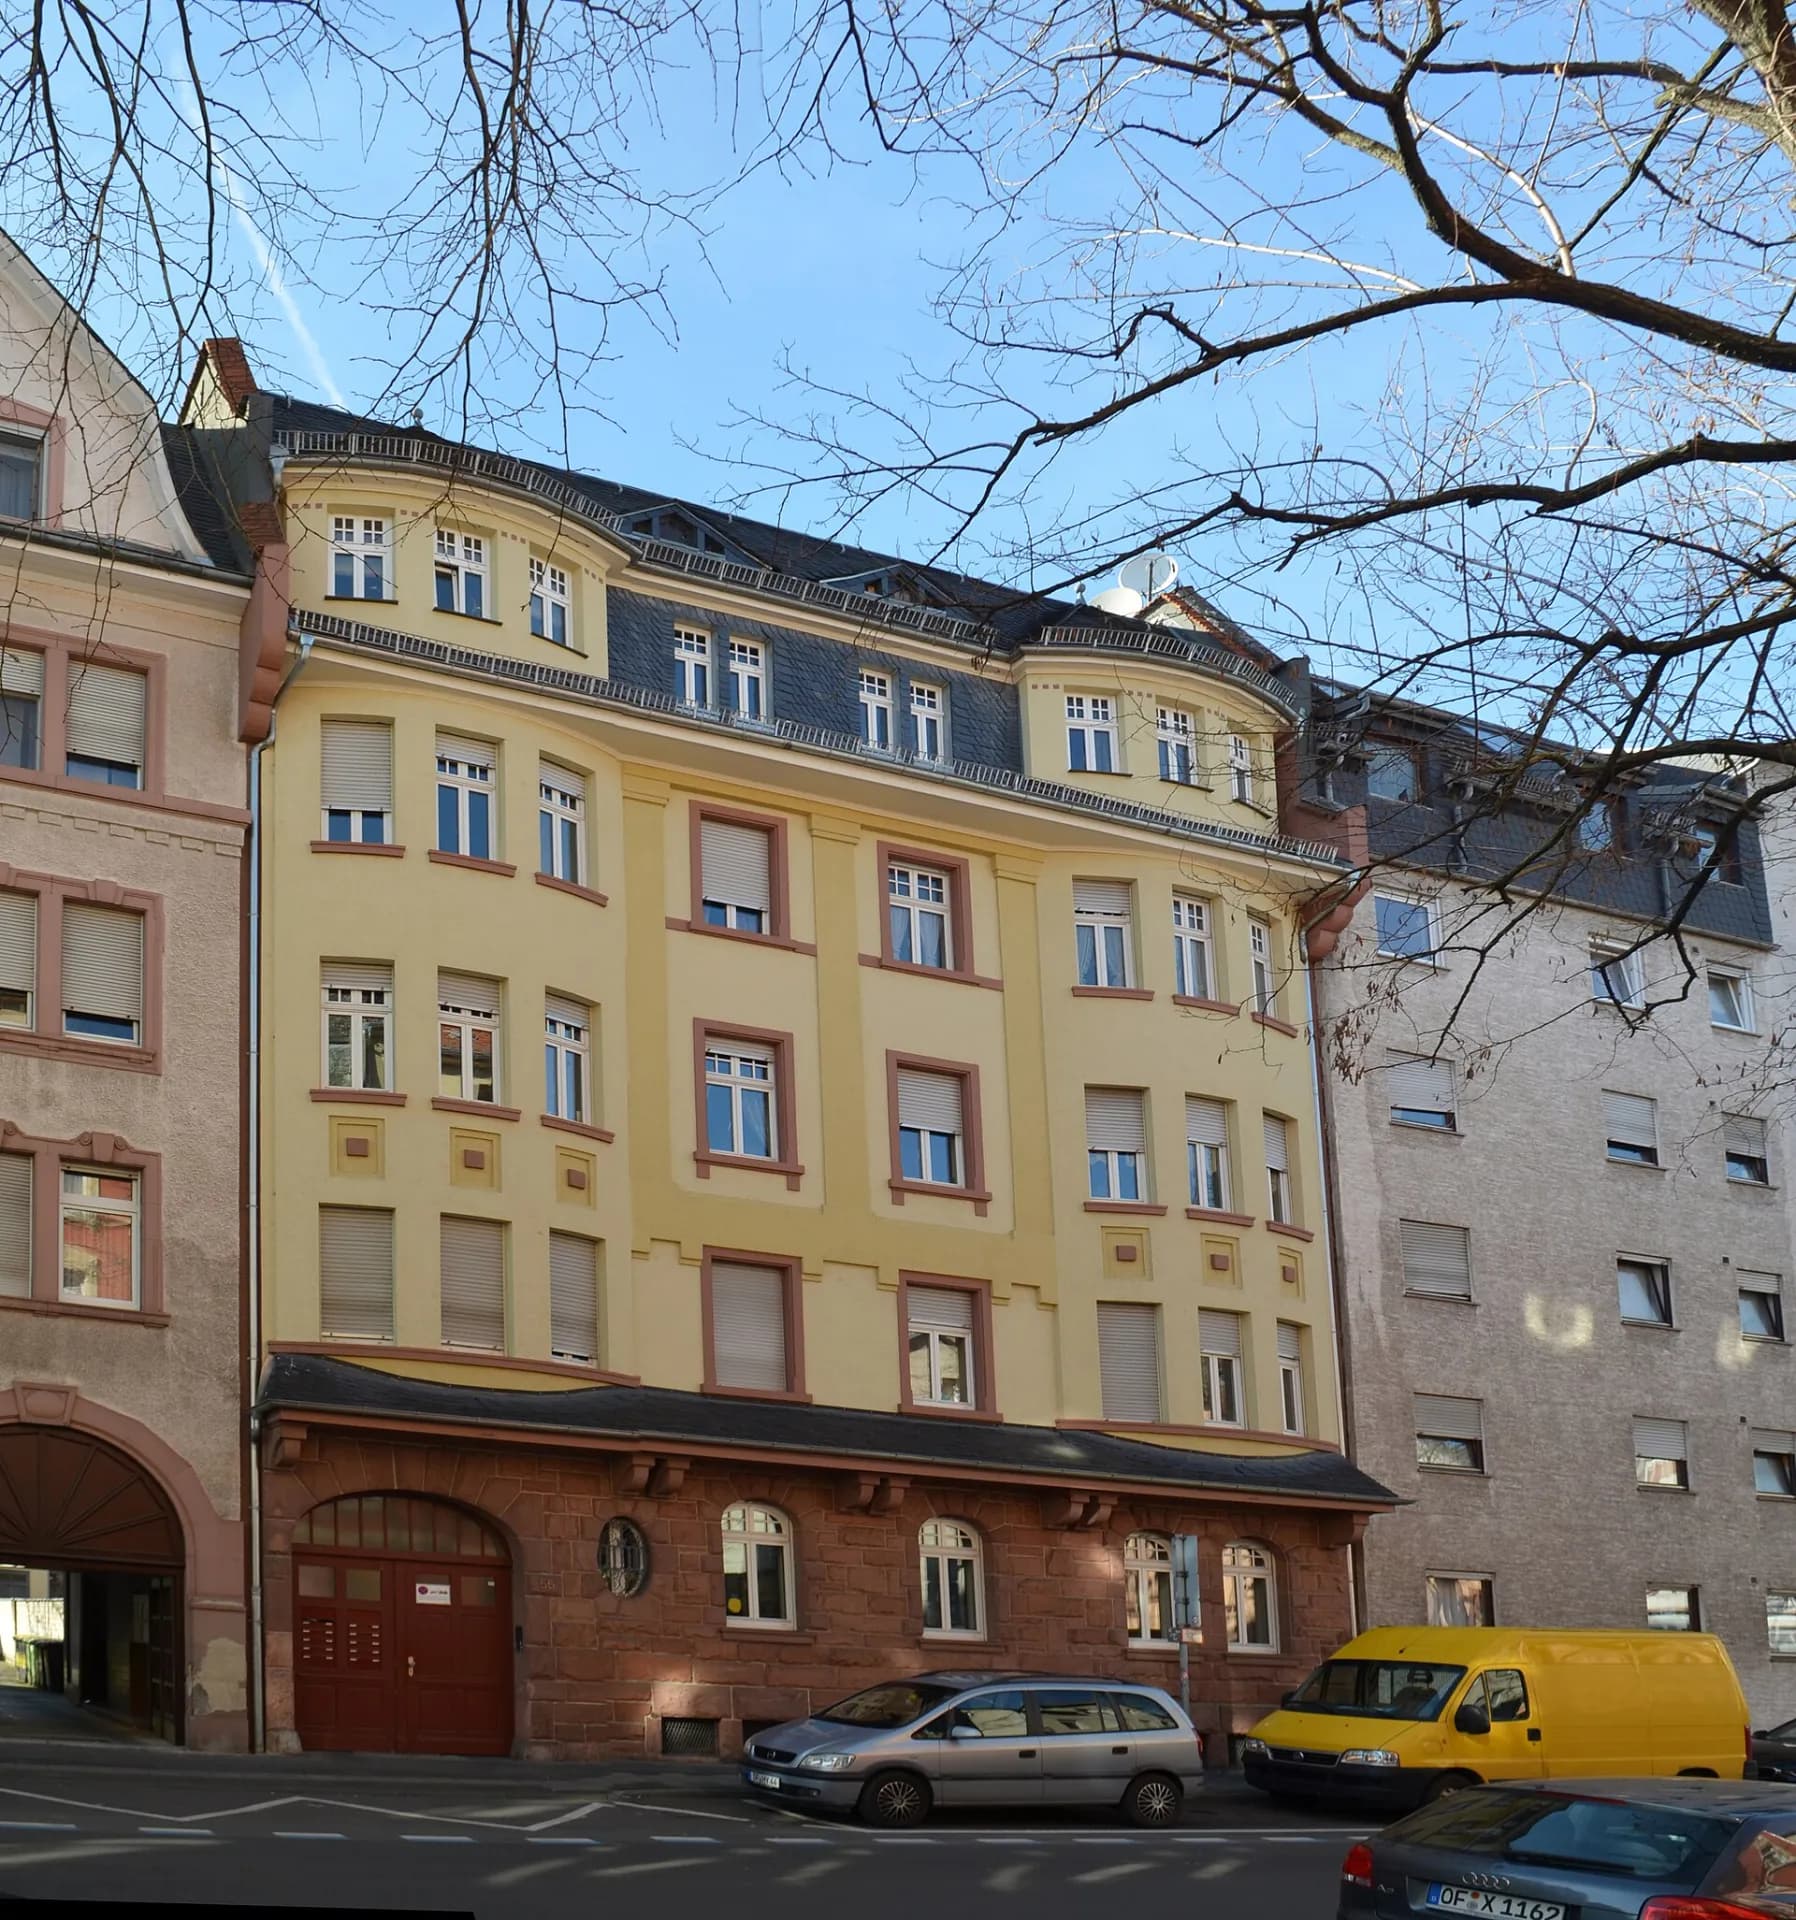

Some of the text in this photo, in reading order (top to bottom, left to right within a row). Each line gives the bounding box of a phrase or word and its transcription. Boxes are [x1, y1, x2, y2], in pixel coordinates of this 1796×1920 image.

[1441, 1888, 1560, 1920] OF X 1162
